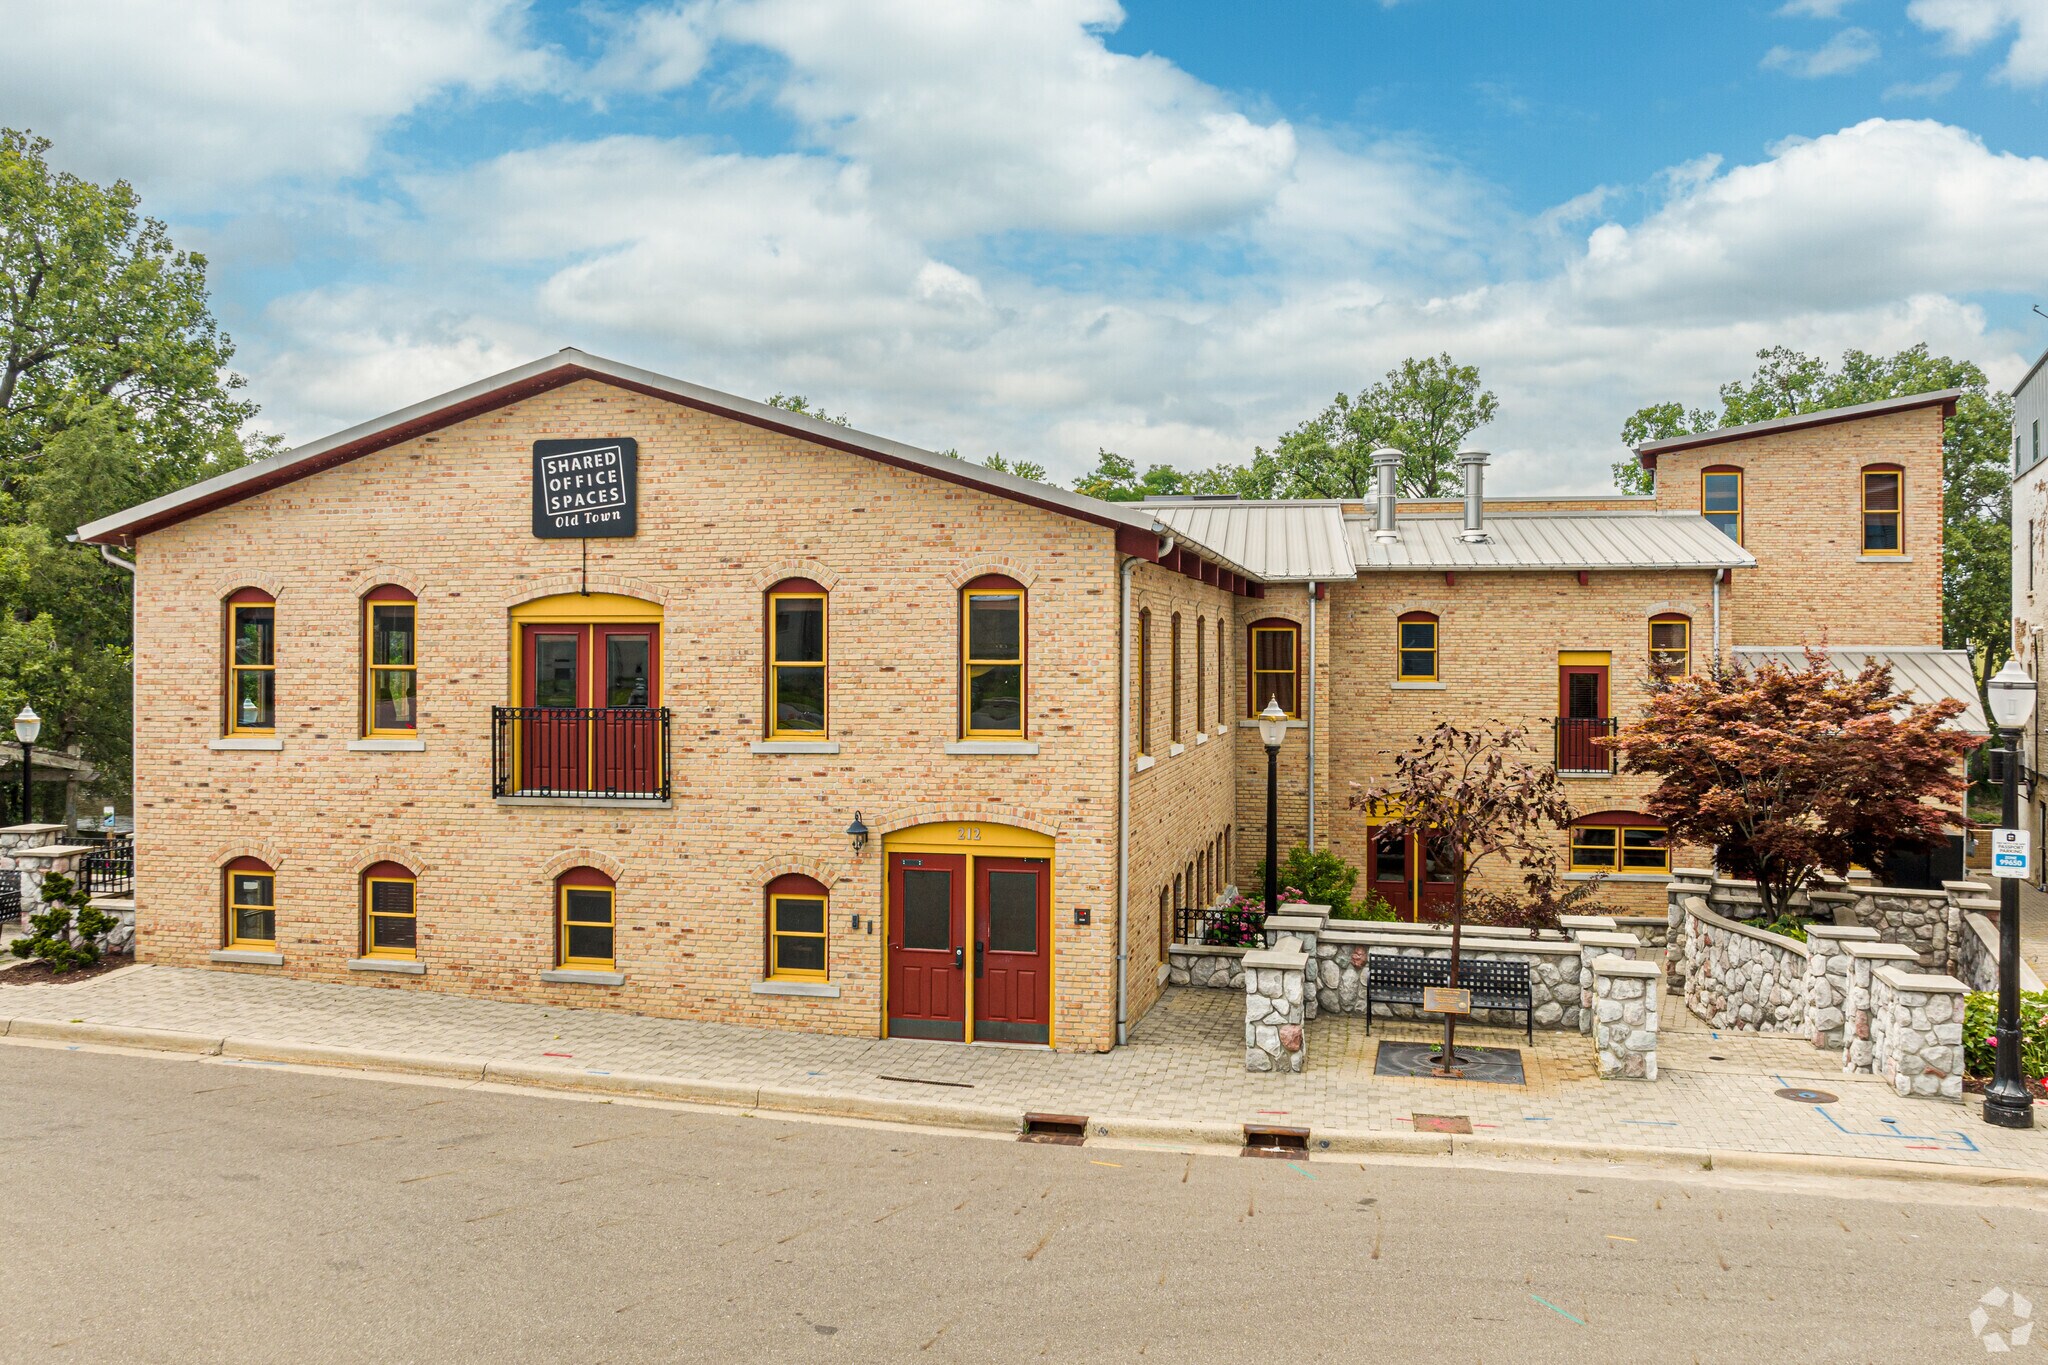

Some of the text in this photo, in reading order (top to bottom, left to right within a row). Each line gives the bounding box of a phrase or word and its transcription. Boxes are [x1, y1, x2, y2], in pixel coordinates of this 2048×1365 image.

[547, 452, 616, 474] SHARED
[549, 470, 617, 491] OFFICE
[551, 487, 619, 510] SPACES
[555, 510, 621, 528] Old Town
[957, 827, 981, 841] 212
